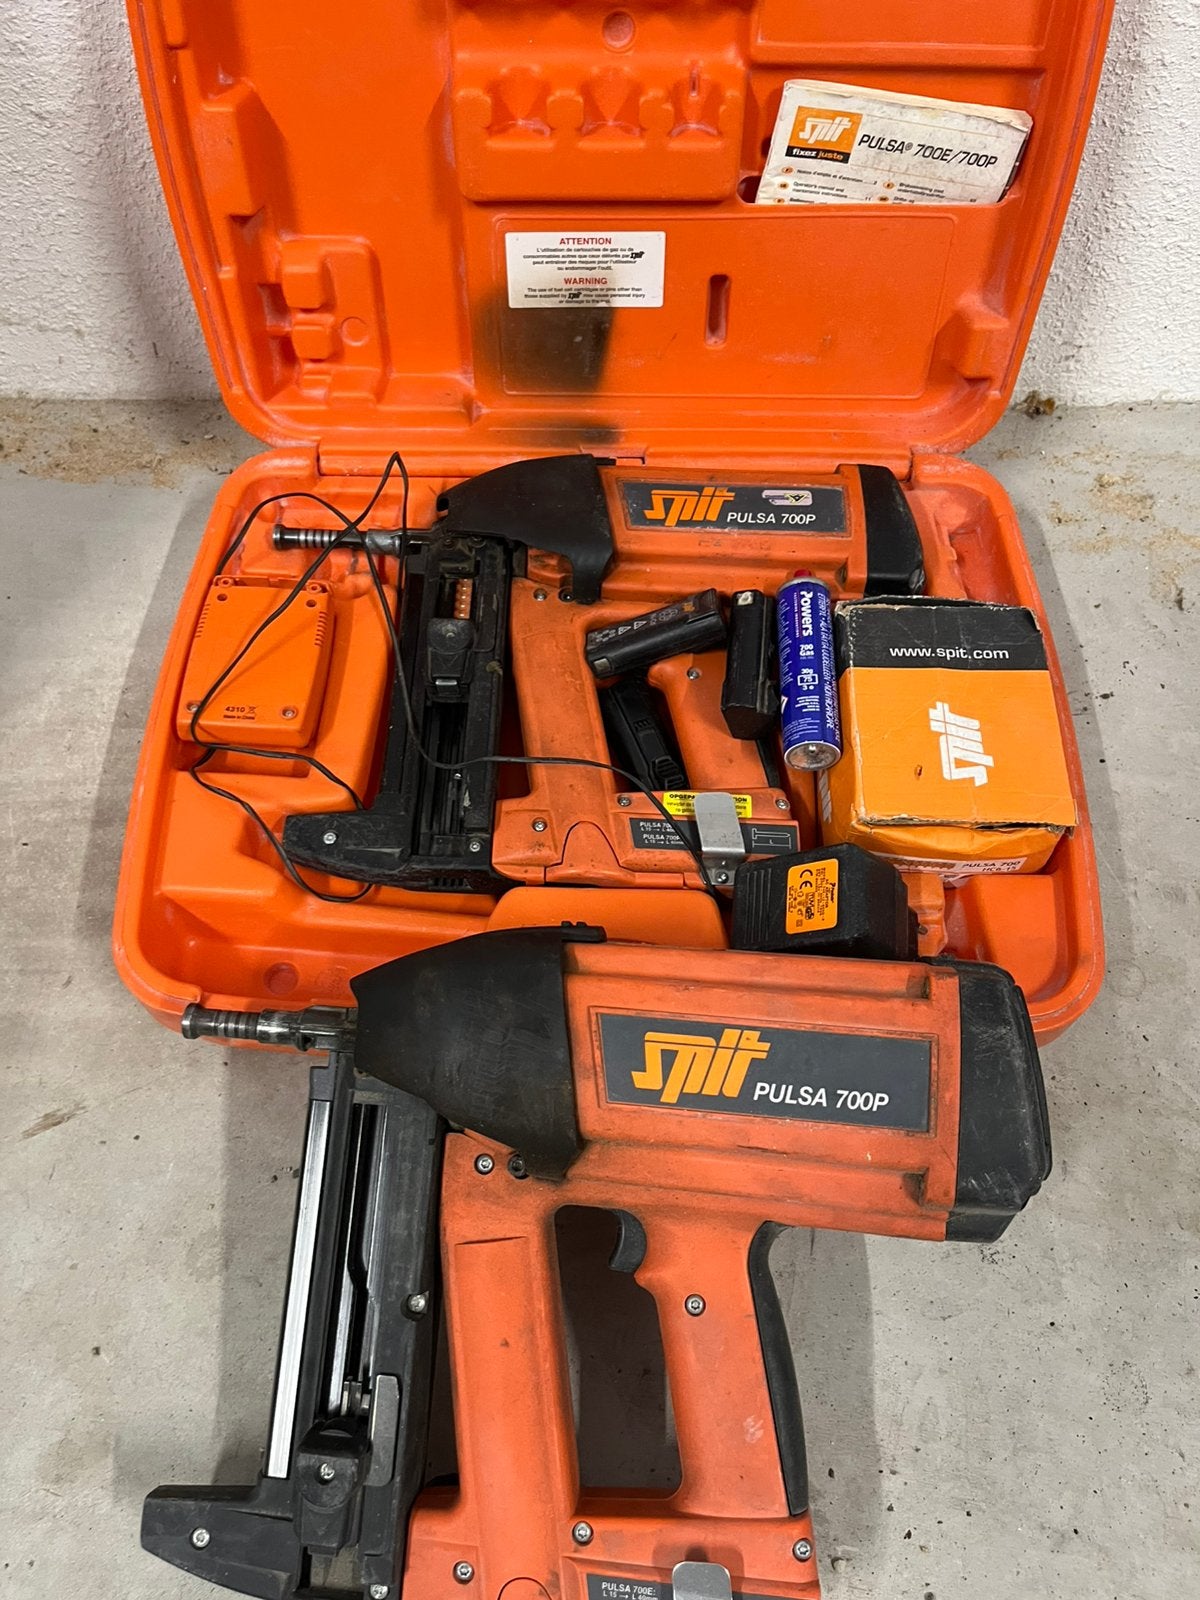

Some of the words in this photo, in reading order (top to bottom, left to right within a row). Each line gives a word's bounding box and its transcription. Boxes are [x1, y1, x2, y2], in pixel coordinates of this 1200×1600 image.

[799, 116, 852, 144] spit
[791, 148, 816, 157] fixez
[817, 151, 843, 161] juste
[913, 143, 998, 168] 700E/700P
[559, 237, 612, 245] ATTENTION
[563, 277, 608, 285] WARNING
[643, 486, 735, 528] spit
[726, 512, 776, 524] PULSA
[781, 513, 816, 525] 700P
[800, 591, 814, 637] Powers
[889, 646, 1010, 660] www.spit.com
[928, 701, 995, 787] spit
[631, 1028, 771, 1104] spit
[753, 1082, 828, 1107] PULSA
[835, 1090, 890, 1112] 700P
[602, 1581, 631, 1593] PULSA
[633, 1585, 656, 1596] 700E:
